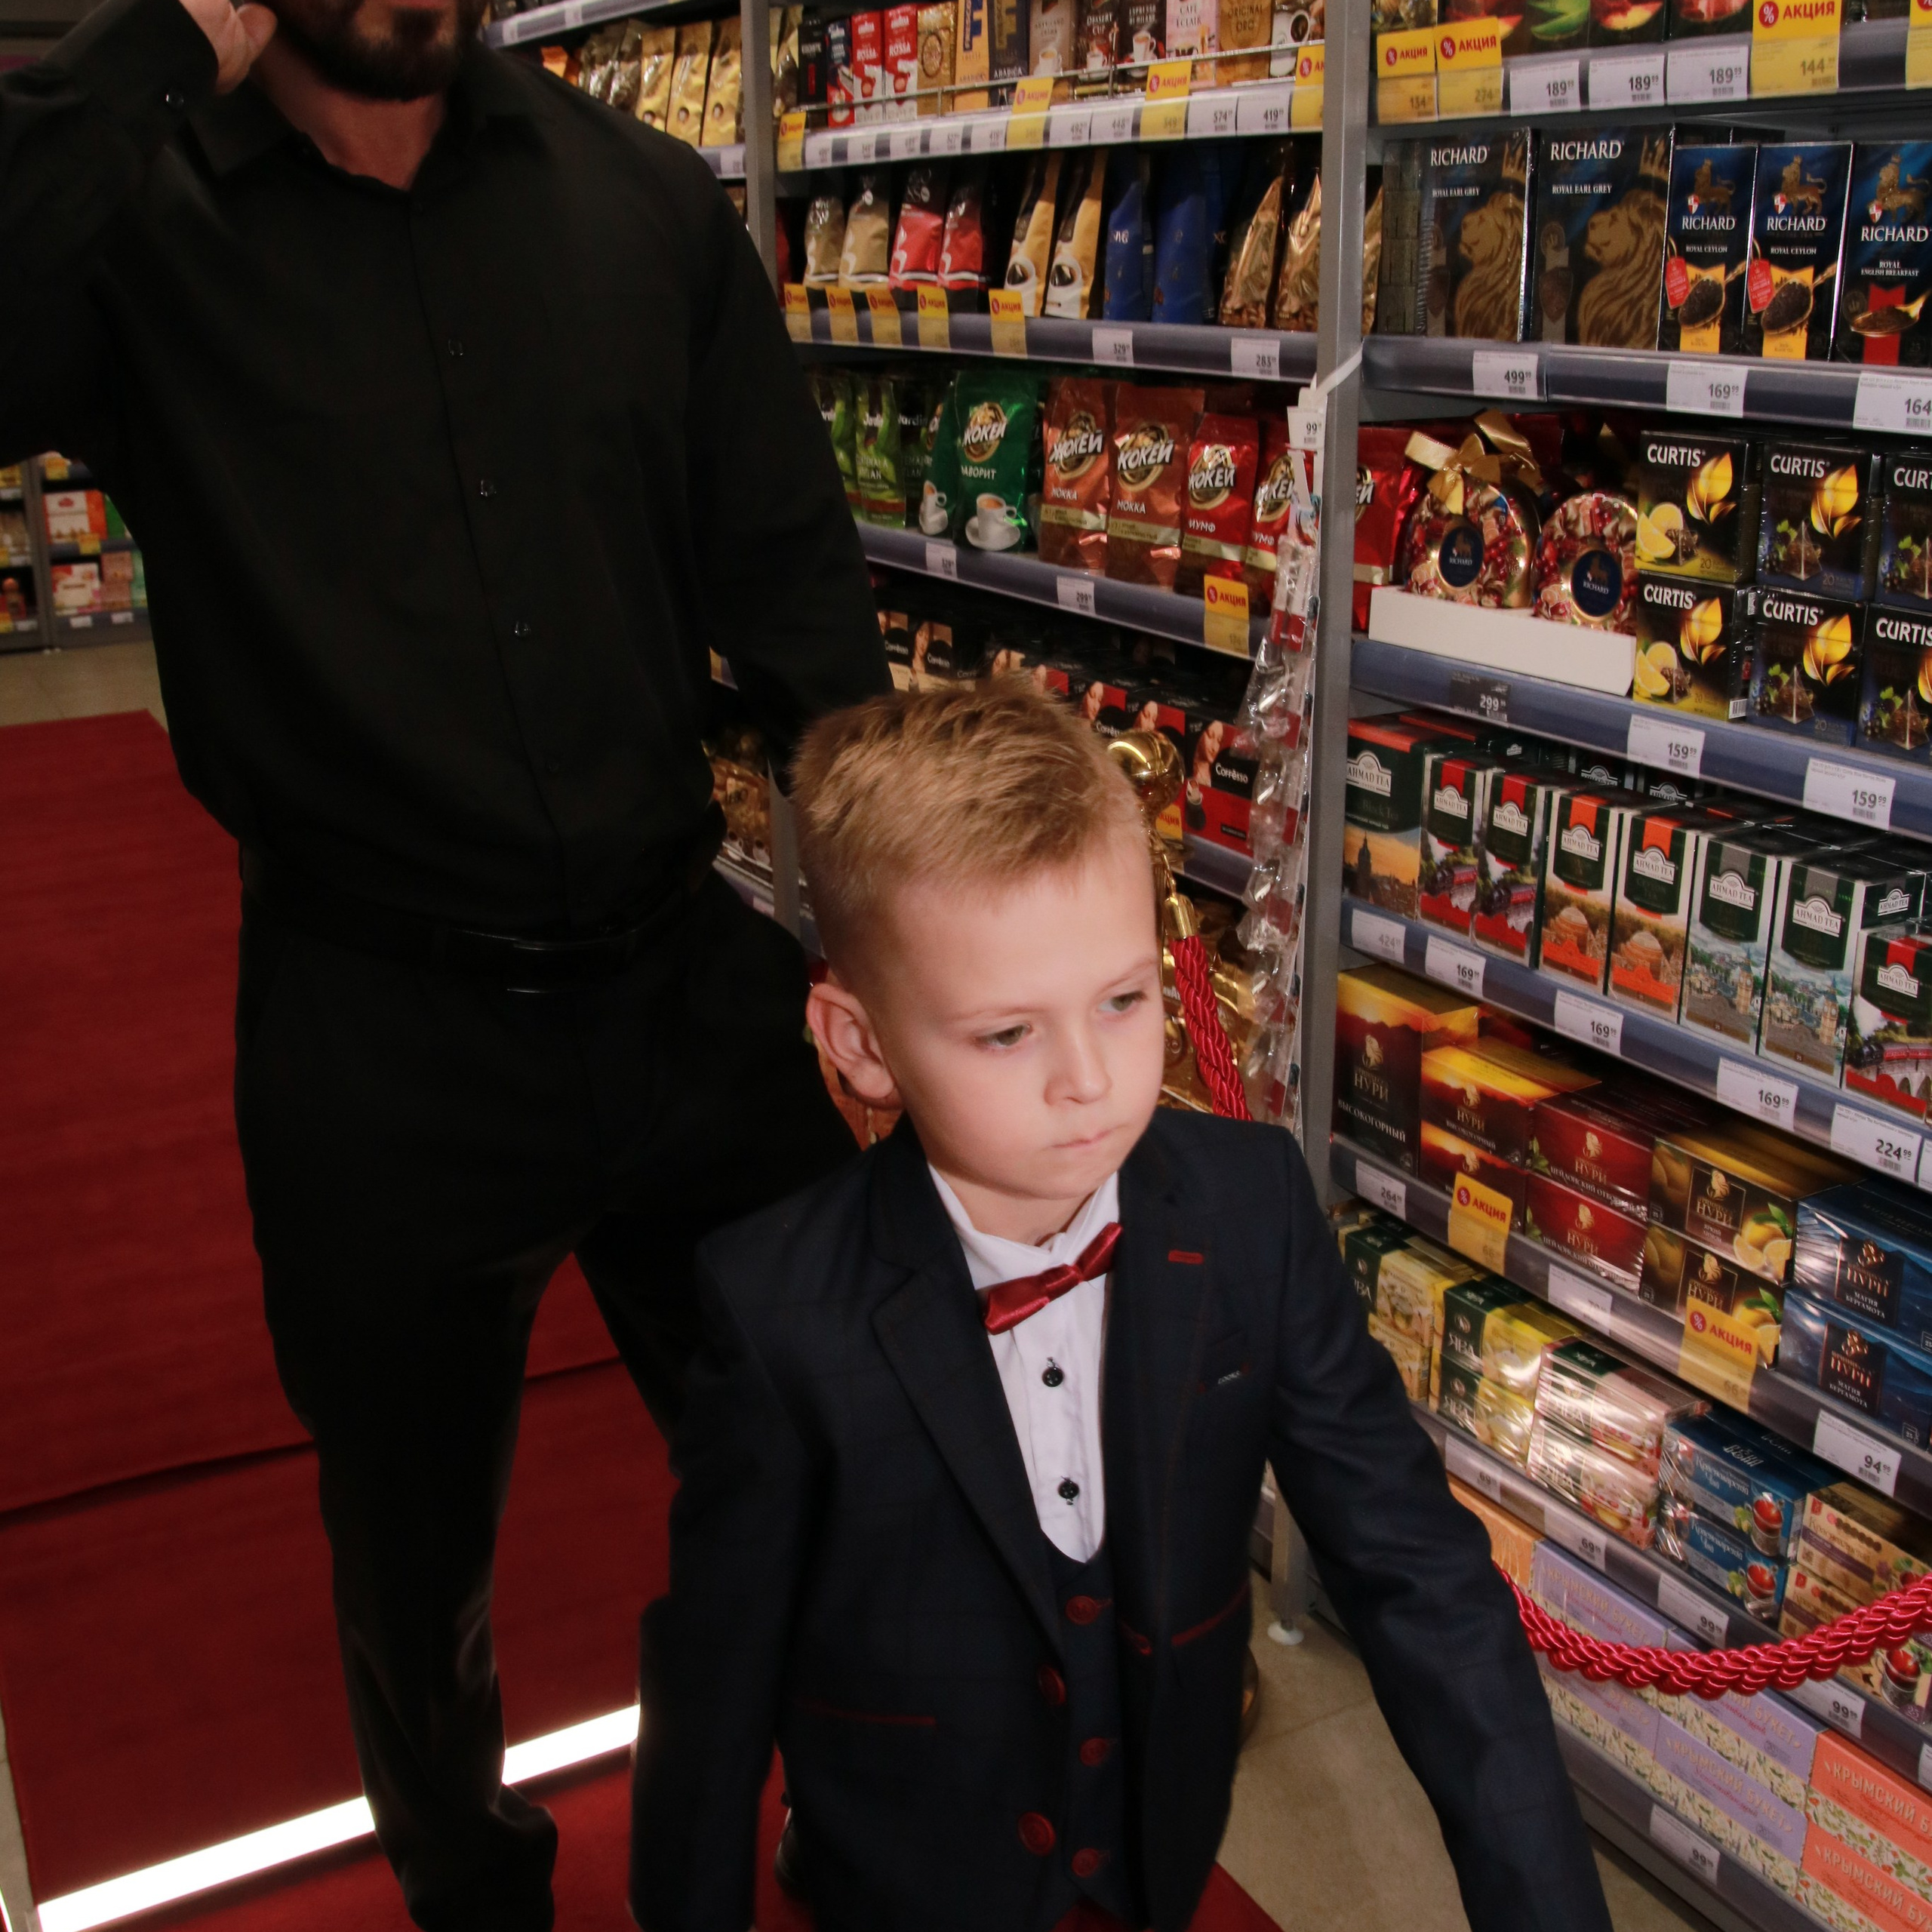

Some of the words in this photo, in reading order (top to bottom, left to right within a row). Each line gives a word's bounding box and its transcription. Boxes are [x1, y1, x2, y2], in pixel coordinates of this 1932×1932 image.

[1783, 1, 1835, 20] АКЦИЯ
[1459, 35, 1497, 53] АКЦИЯ
[1400, 48, 1428, 60] АКЦИЯ
[1710, 68, 1734, 85] 189
[1800, 59, 1825, 75] 144
[1161, 75, 1187, 89] АКЦИЯ
[1546, 82, 1567, 97] 189
[1629, 76, 1651, 91] 189
[1430, 146, 1488, 166] RICHARD
[1550, 140, 1623, 161] RICHARD
[1682, 216, 1735, 230] RICHARD
[1767, 216, 1826, 231] RICHARD
[1861, 226, 1929, 242] RICHARD
[1686, 245, 1703, 253] ROYAL
[1704, 245, 1727, 254] CEYLON
[1770, 247, 1789, 255] ROYAL
[1791, 247, 1817, 255] CEYLON
[1879, 260, 1901, 269] ROYAL
[1504, 371, 1525, 384] 499
[1708, 384, 1730, 398] 169
[1905, 398, 1932, 415] 164
[1306, 423, 1317, 434] 99
[1048, 430, 1103, 463] ЖОКЕЙ
[1118, 441, 1174, 471] ЖОКЕЙ
[1647, 444, 1701, 468] CURTIS
[1770, 454, 1826, 478] CURTIS
[1118, 500, 1146, 514] МОККА
[1449, 557, 1473, 566] RICHARD
[1583, 581, 1609, 595] RICHARD
[1823, 574, 1835, 586] 20
[1220, 592, 1246, 608] АКЦИЯ
[1644, 583, 1694, 610] CURTIS
[1763, 598, 1820, 627] CURTIS
[1875, 617, 1932, 648] CURTIS
[1480, 694, 1499, 711] 299
[1667, 742, 1689, 760] 159
[1347, 767, 1374, 785] AHMAD
[1375, 775, 1390, 788] TEA
[1435, 796, 1454, 809] AHMAD
[1456, 802, 1468, 814] TEA
[1852, 789, 1877, 809] 159
[1495, 811, 1514, 825] AHMAD
[1515, 819, 1527, 830] TEA
[1563, 835, 1584, 851] AHMAD
[1586, 842, 1598, 855] TEA
[1635, 858, 1657, 874] AHMAD
[1660, 866, 1674, 878] TEA
[1711, 882, 1737, 900] AHMAD
[1739, 891, 1753, 904] TEA
[1795, 907, 1824, 925] AHMAD
[1825, 916, 1840, 931] TEA
[1457, 964, 1473, 981] 169
[1878, 972, 1903, 986] AHMAD
[1904, 980, 1918, 992] TEA
[1590, 1020, 1610, 1038] 169
[1354, 1072, 1389, 1103] НУРИ
[1758, 1089, 1781, 1109] 169
[1337, 1098, 1406, 1143] ВЫСОКОГОРНЫЙ
[1457, 1107, 1486, 1132] НУРИ
[1875, 1139, 1902, 1161] 224
[1574, 1158, 1607, 1186] НУРИ
[1380, 1187, 1396, 1203] 264
[1472, 1198, 1506, 1223] АКЦИЯ
[1697, 1201, 1733, 1227] НУРИ
[1687, 1284, 1724, 1310] НУРИ
[1846, 1294, 1885, 1319] БЕРГАМОТА
[1854, 1291, 1878, 1308] МАГИЯ
[1709, 1325, 1752, 1355] АКЦИЯ
[1829, 1383, 1868, 1409] БЕРГАМОТА
[1837, 1380, 1861, 1398] МАГИЯ
[1864, 1454, 1882, 1475] 94
[1701, 1616, 1715, 1634] 99
[1833, 1700, 1850, 1718] 99
[1834, 1761, 1916, 1824] КРЫМСКИЙ
[1824, 1848, 1903, 1912] КРЫМСКИЙ
